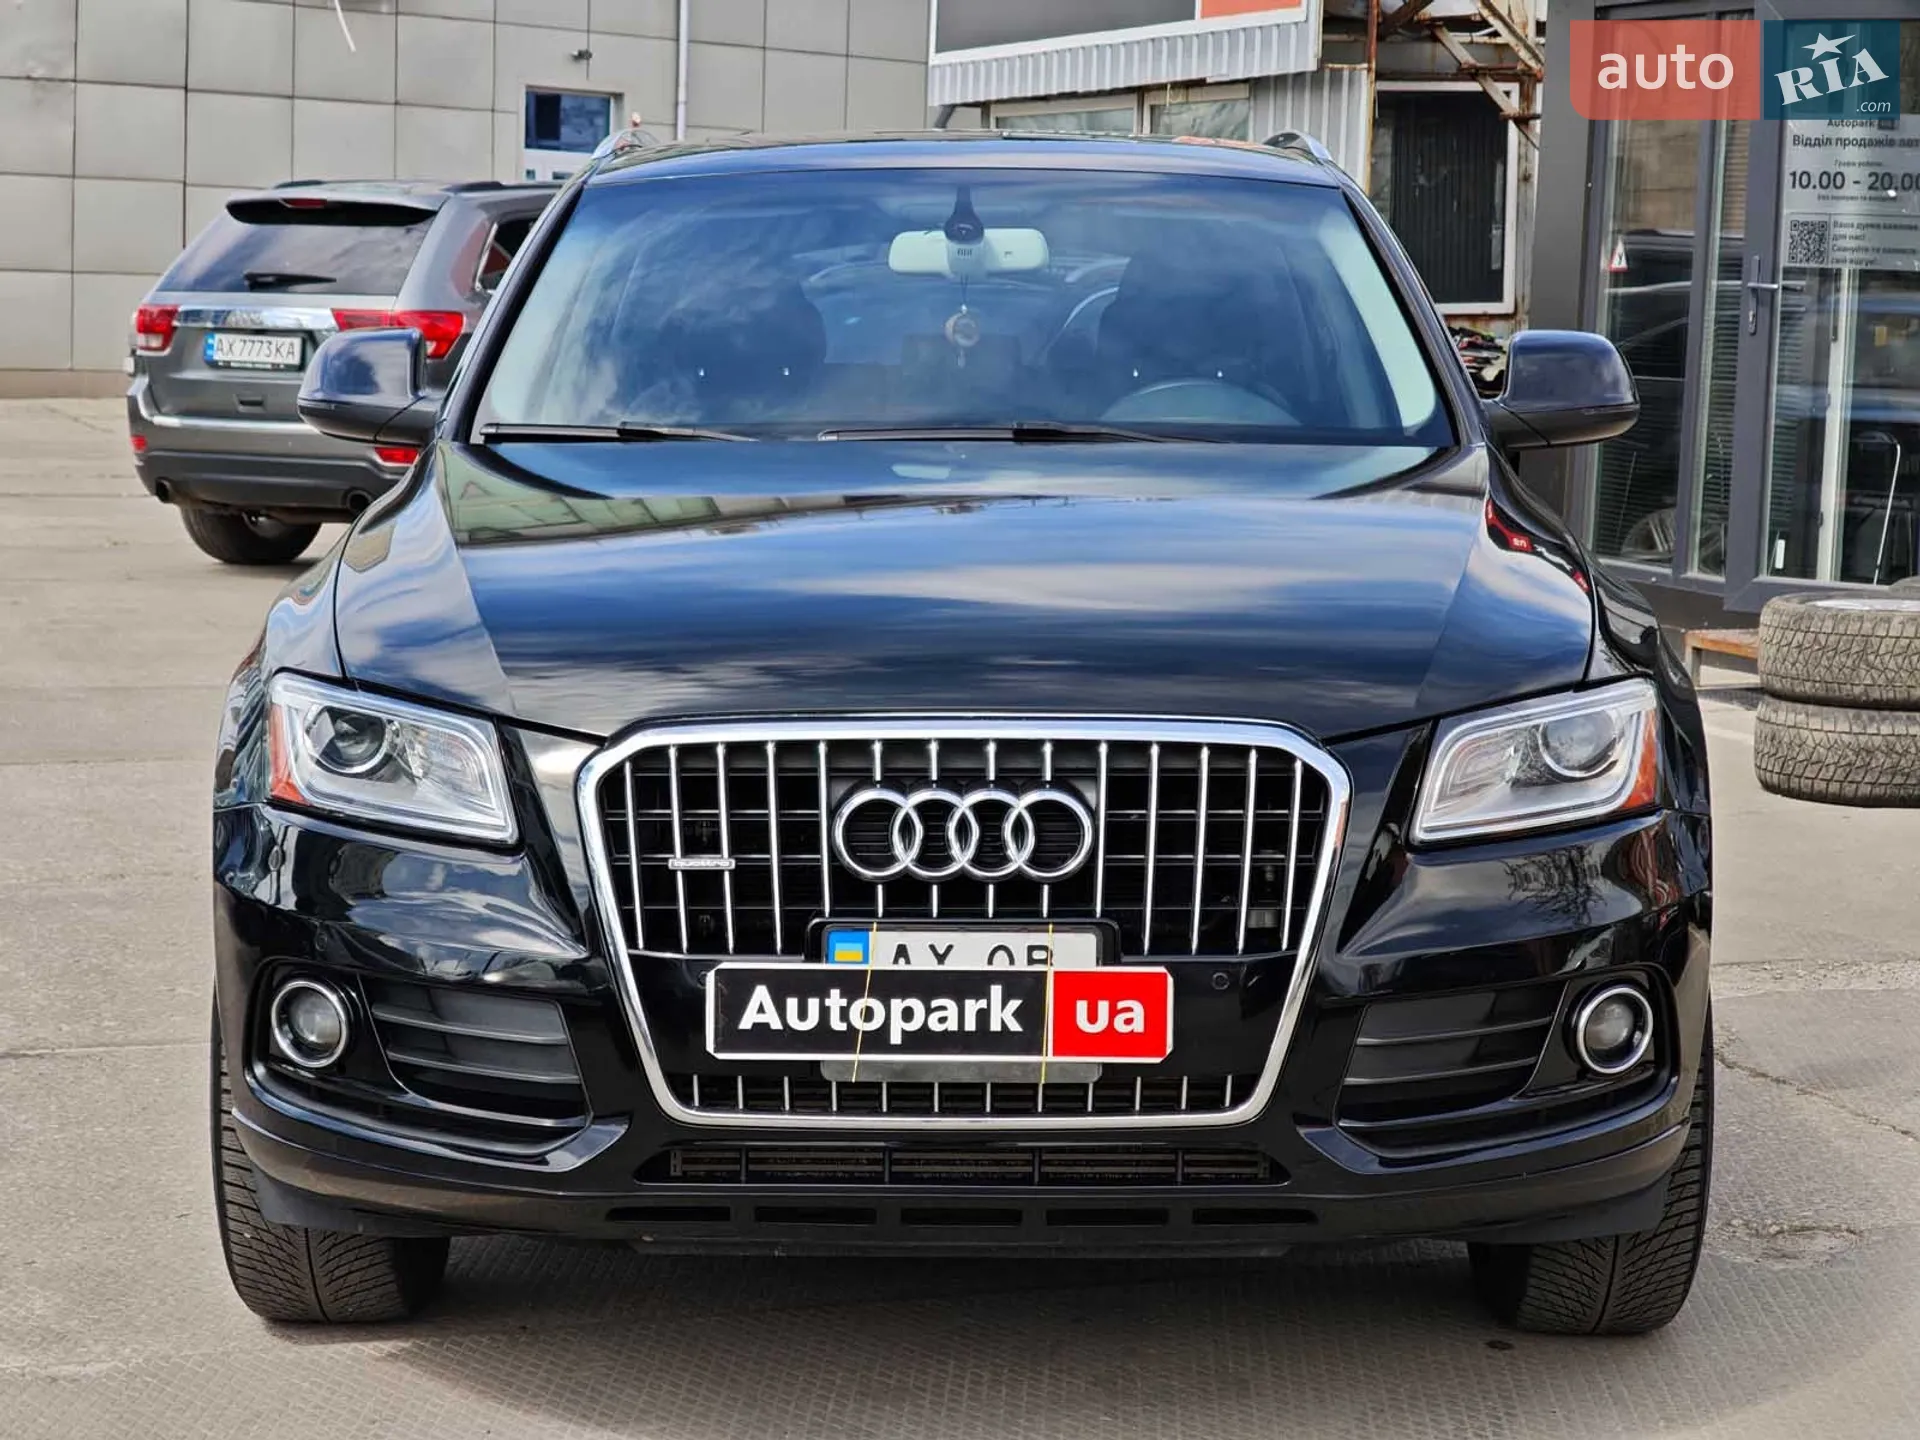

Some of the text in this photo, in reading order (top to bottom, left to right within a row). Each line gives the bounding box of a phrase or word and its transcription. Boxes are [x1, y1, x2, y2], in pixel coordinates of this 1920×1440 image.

[1827, 118, 1875, 129] Autopark
[1793, 134, 1832, 148] Відділ
[1835, 135, 1896, 149] продажів
[1789, 170, 1846, 189] 10.00
[738, 984, 1146, 1045] Autopark ua
